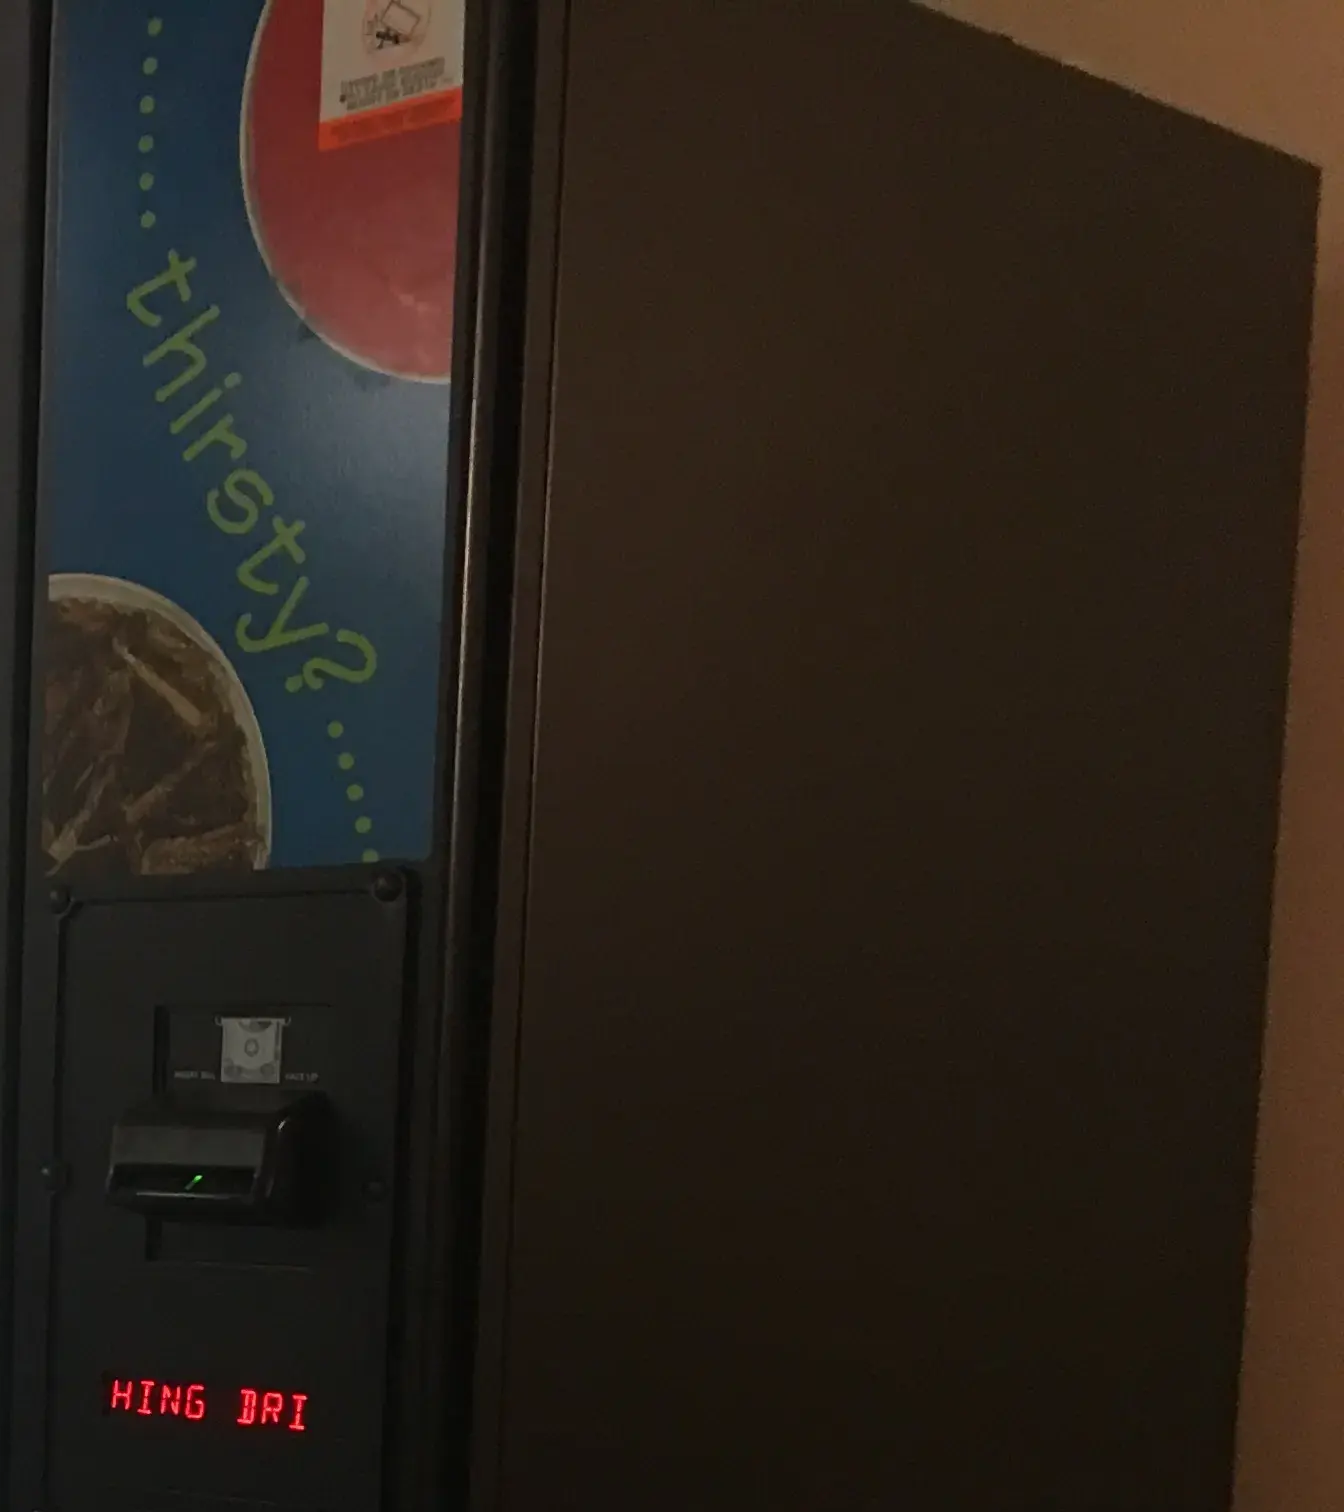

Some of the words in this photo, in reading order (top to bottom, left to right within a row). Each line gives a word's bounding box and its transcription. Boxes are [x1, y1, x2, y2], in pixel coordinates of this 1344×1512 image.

[127, 249, 378, 695] thirsty?
[111, 1379, 205, 1420] HING
[237, 1388, 308, 1431] DRI
